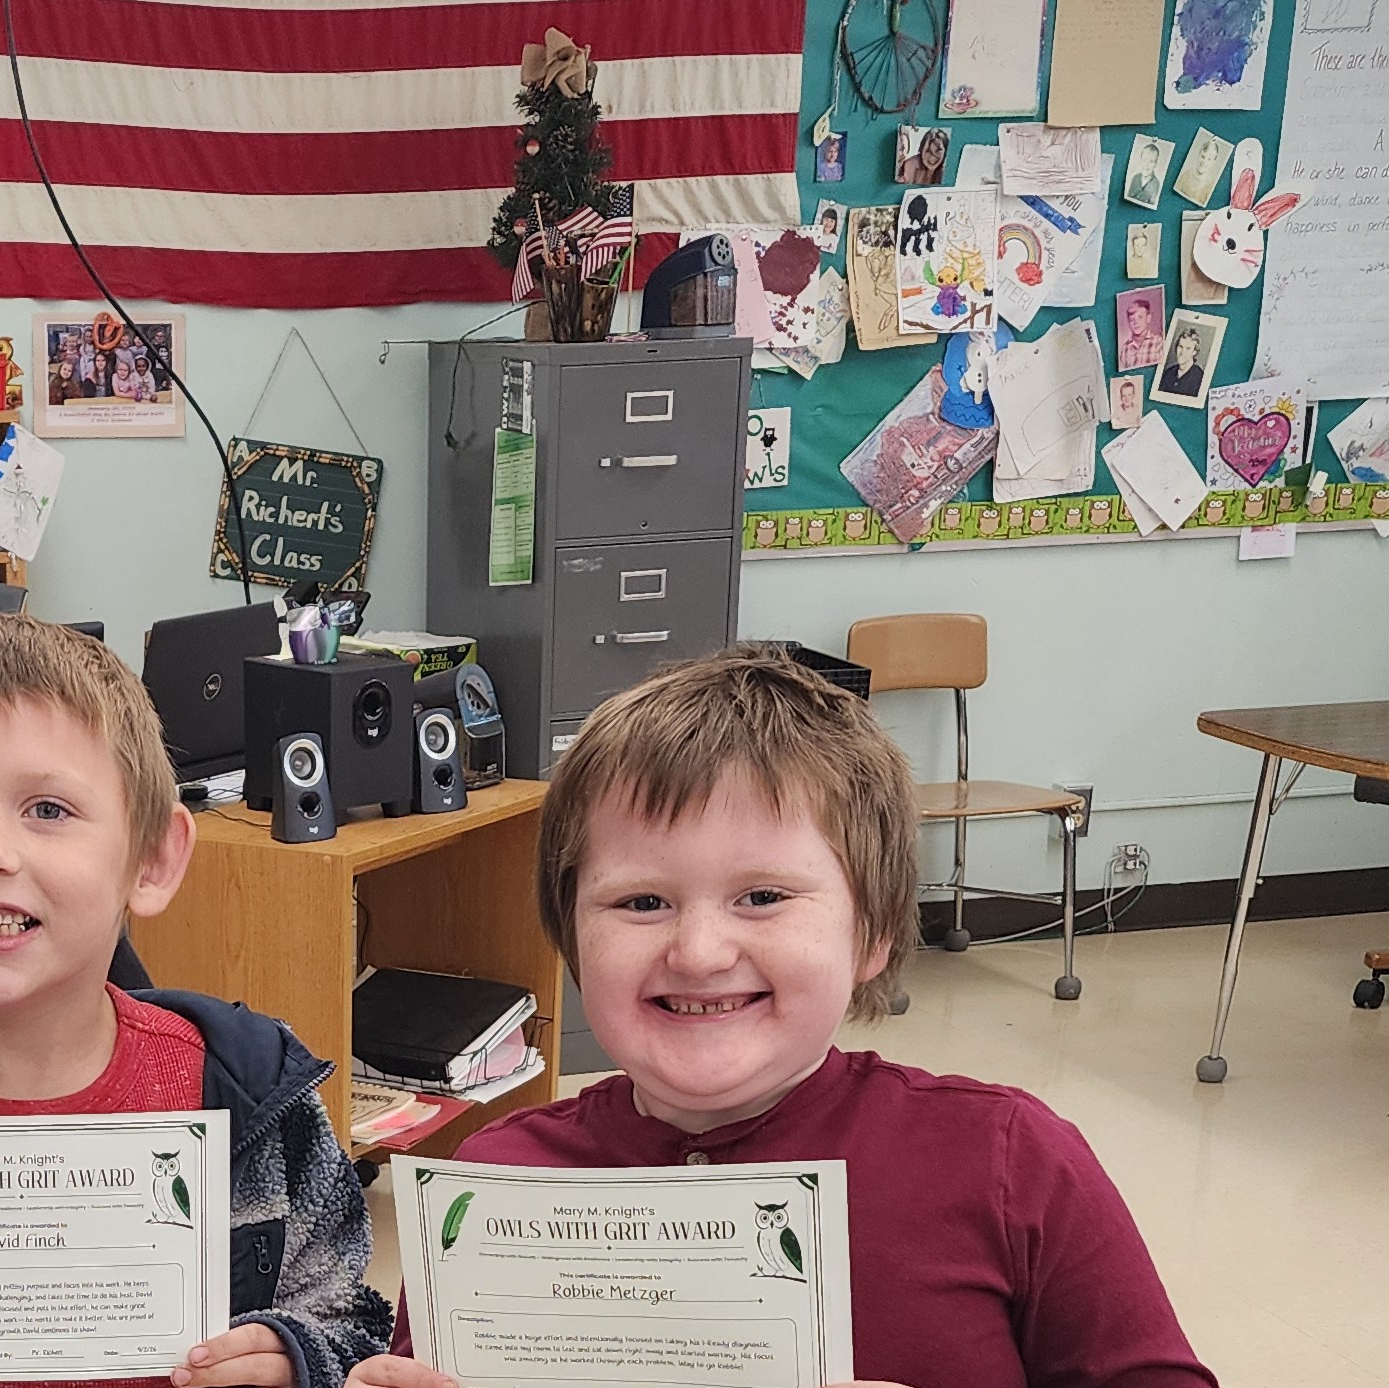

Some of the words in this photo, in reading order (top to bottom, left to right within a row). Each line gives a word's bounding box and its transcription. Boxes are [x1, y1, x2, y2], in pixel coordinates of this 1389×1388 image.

[1311, 40, 1342, 71] These
[1347, 53, 1366, 69] are
[1324, 161, 1345, 180] she
[1356, 167, 1378, 179] can
[1349, 192, 1380, 205] dance
[232, 440, 250, 463] A
[271, 457, 319, 488] Mr.
[361, 460, 379, 482] B
[240, 489, 344, 534] Richert's
[250, 533, 324, 571] Class
[215, 553, 232, 577] C
[423, 661, 453, 672] GREEN
[430, 652, 449, 662] TEA
[3, 1155, 16, 1165] M.
[18, 1153, 65, 1167] Knight's
[17, 1169, 59, 1189] GRIT
[65, 1167, 134, 1188] AWARD
[553, 1206, 584, 1219] Mary
[587, 1206, 601, 1216] M.
[604, 1205, 655, 1219] Knight's
[25, 1231, 67, 1248] Finch
[486, 1217, 541, 1238] OWLS
[546, 1221, 597, 1240] WITH
[604, 1221, 650, 1240] GRIT
[656, 1220, 736, 1240] AWARD
[552, 1283, 605, 1300] Robbie
[610, 1285, 678, 1306] Metzger
